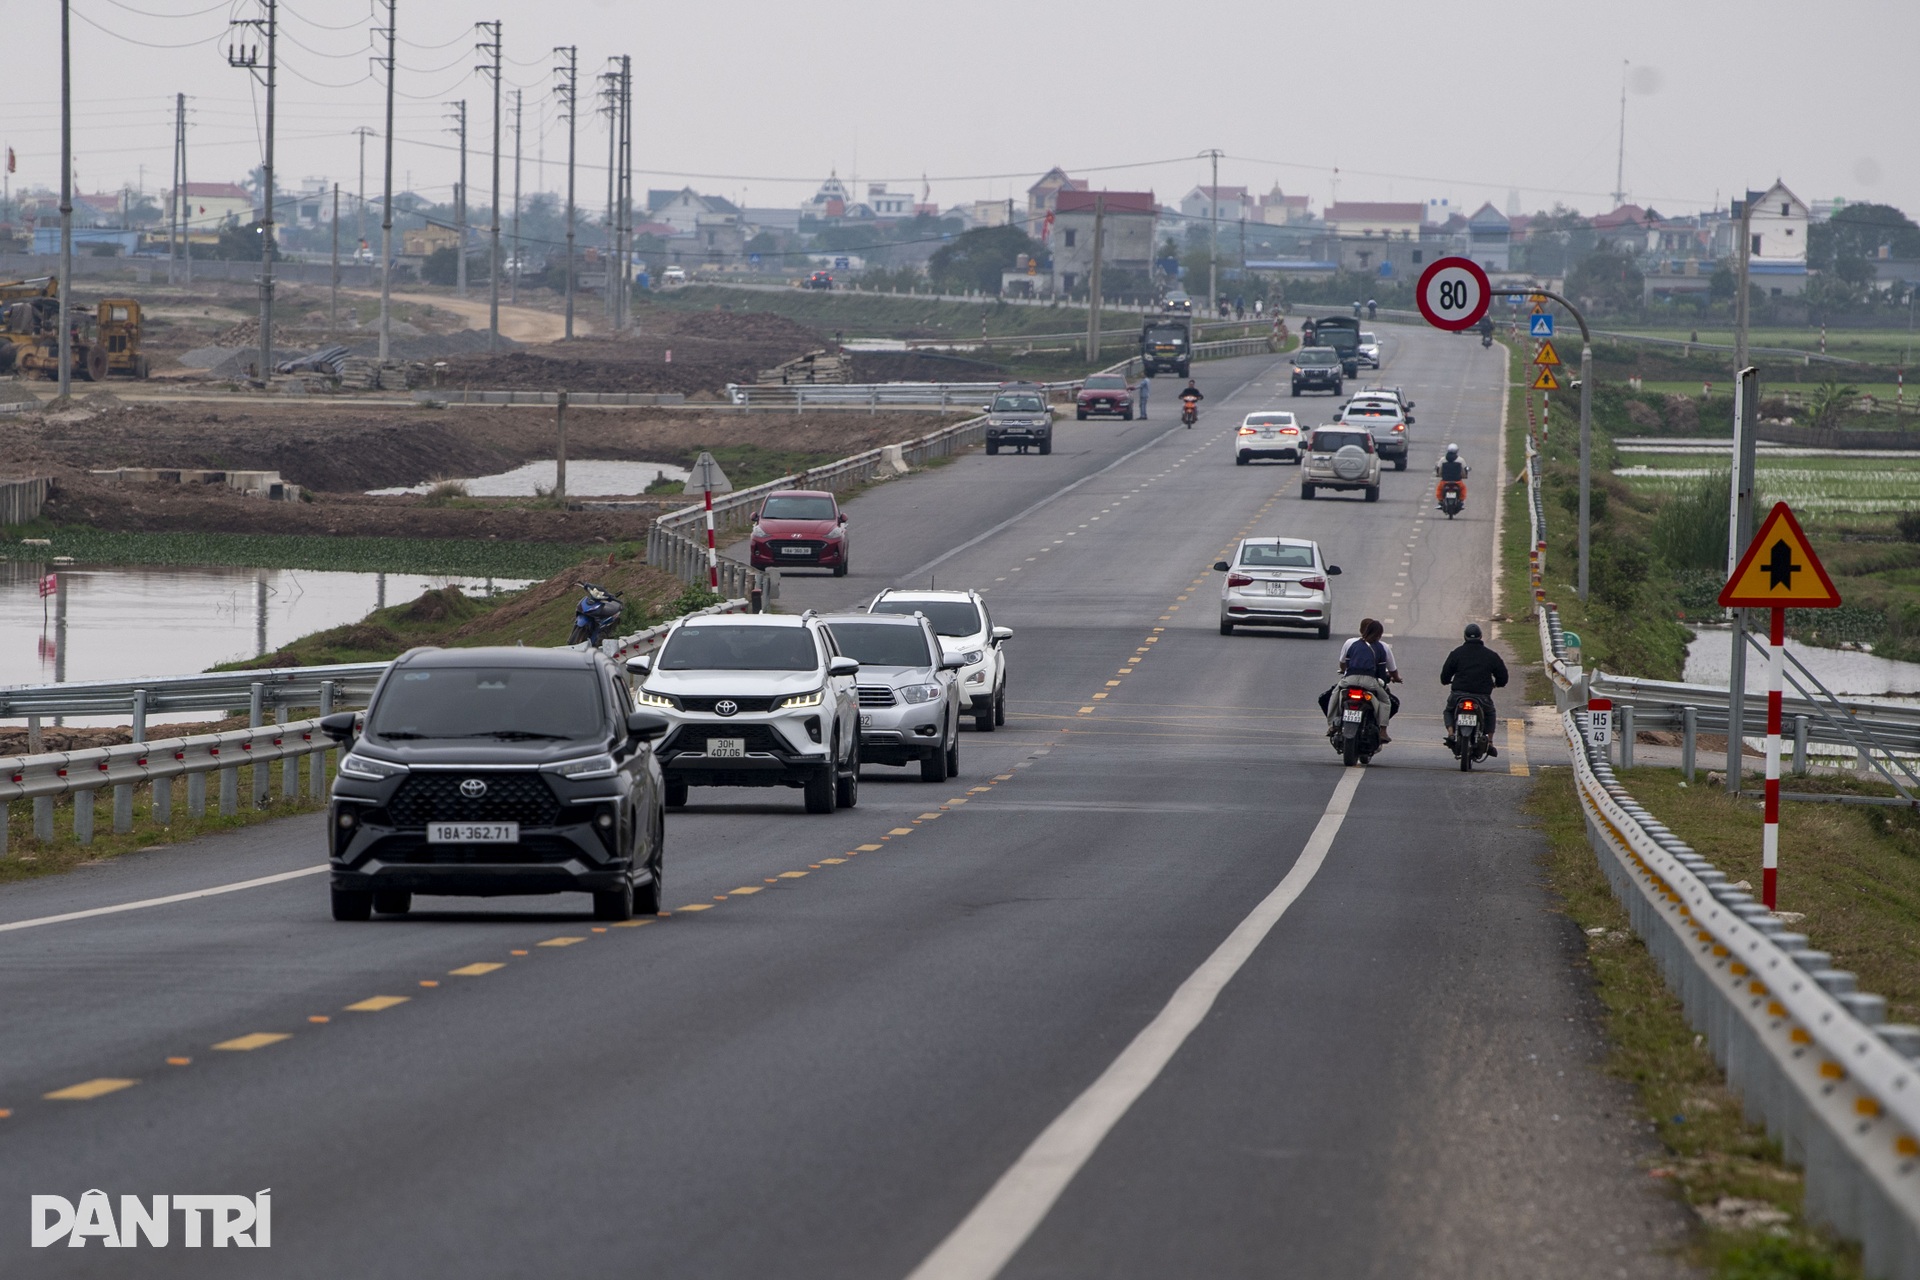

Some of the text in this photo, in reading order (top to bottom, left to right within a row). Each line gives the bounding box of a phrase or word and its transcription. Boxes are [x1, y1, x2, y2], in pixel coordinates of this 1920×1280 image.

[1440, 280, 1467, 310] 80
[1593, 713, 1607, 725] H5
[1593, 732, 1605, 742] 43
[717, 740, 734, 748] 30H
[711, 749, 741, 757] 407.06
[437, 827, 509, 840] 18A-362.71
